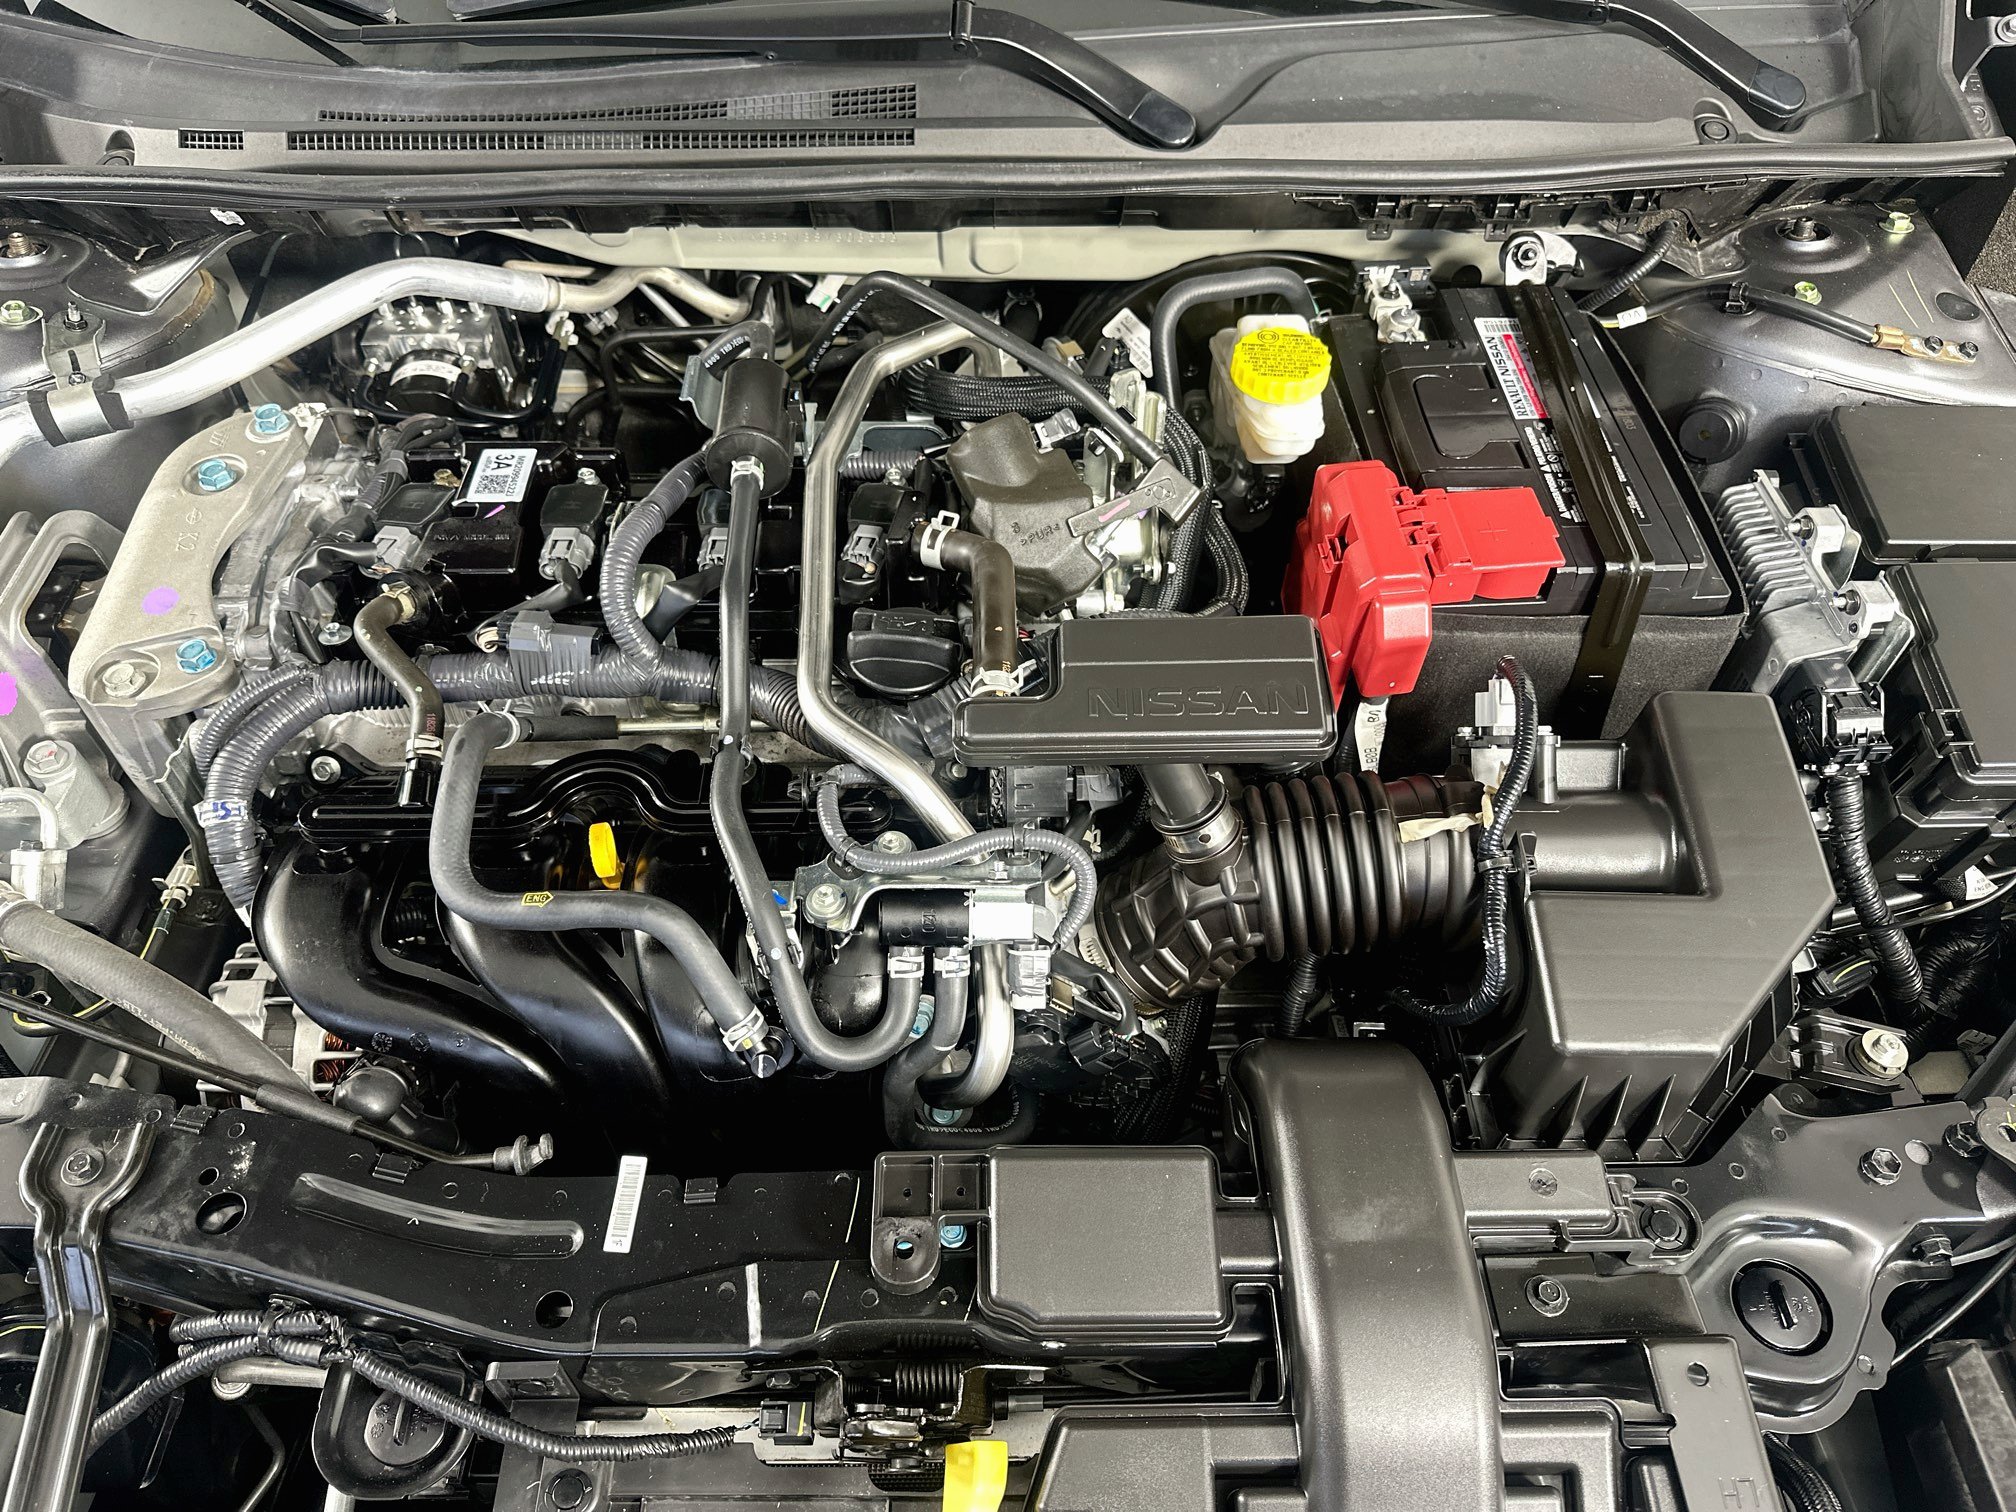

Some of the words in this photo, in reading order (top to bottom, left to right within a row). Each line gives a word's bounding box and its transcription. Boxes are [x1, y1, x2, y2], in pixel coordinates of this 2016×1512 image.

[1484, 336, 1512, 376] NISSAN
[1503, 378, 1529, 416] RENAULT
[491, 454, 516, 471] 3A
[1088, 682, 1309, 718] NISSAN
[526, 894, 548, 903] ENG
